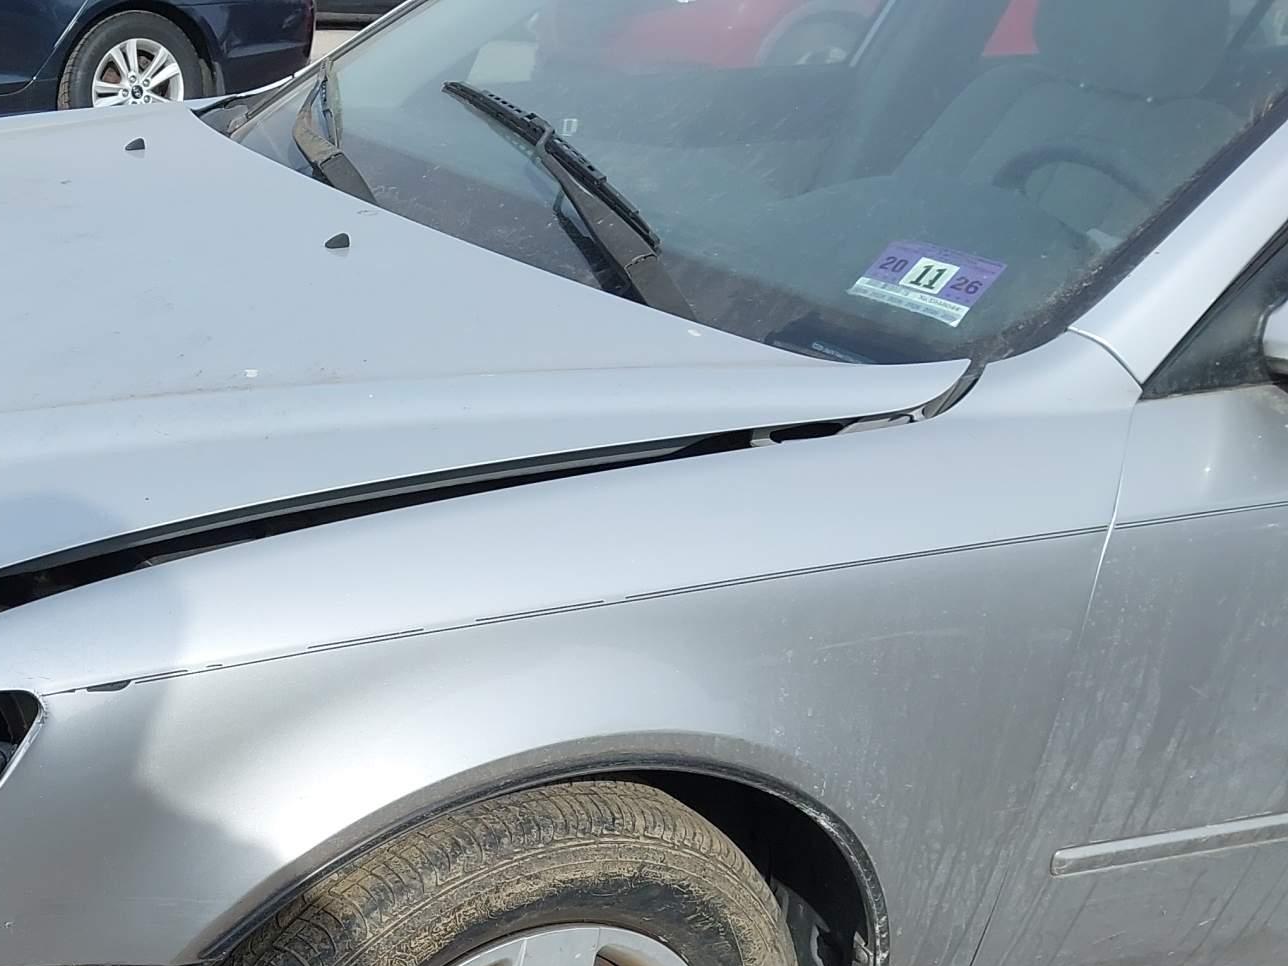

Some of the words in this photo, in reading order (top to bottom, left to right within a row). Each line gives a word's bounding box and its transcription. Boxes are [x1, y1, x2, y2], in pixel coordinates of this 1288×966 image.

[879, 256, 909, 274] 20
[910, 264, 947, 290] 11
[950, 276, 983, 295] 26
